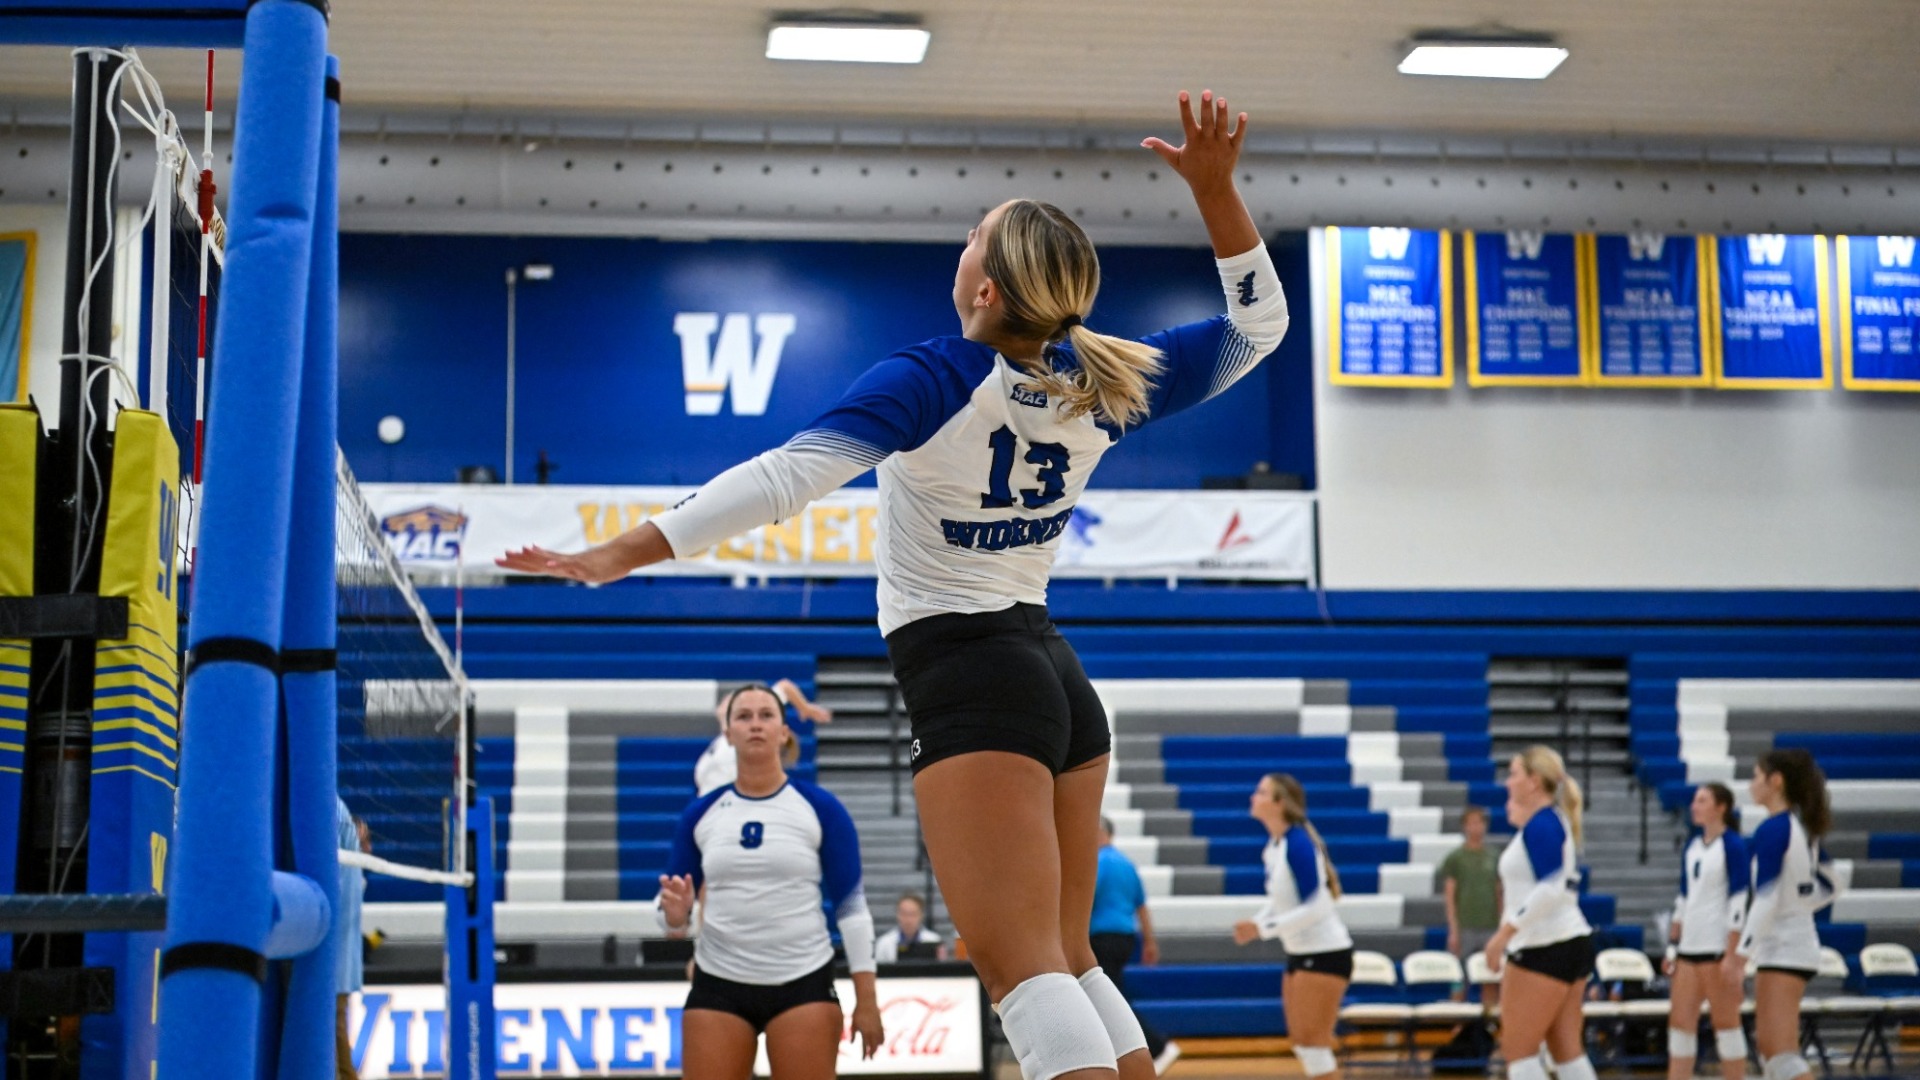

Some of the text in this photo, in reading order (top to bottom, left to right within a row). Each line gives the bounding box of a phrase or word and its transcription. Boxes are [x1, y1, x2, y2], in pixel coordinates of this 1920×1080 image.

[673, 312, 796, 416] W
[1013, 390, 1047, 405] MAC
[981, 424, 1070, 509] 13
[739, 820, 764, 849] 9
